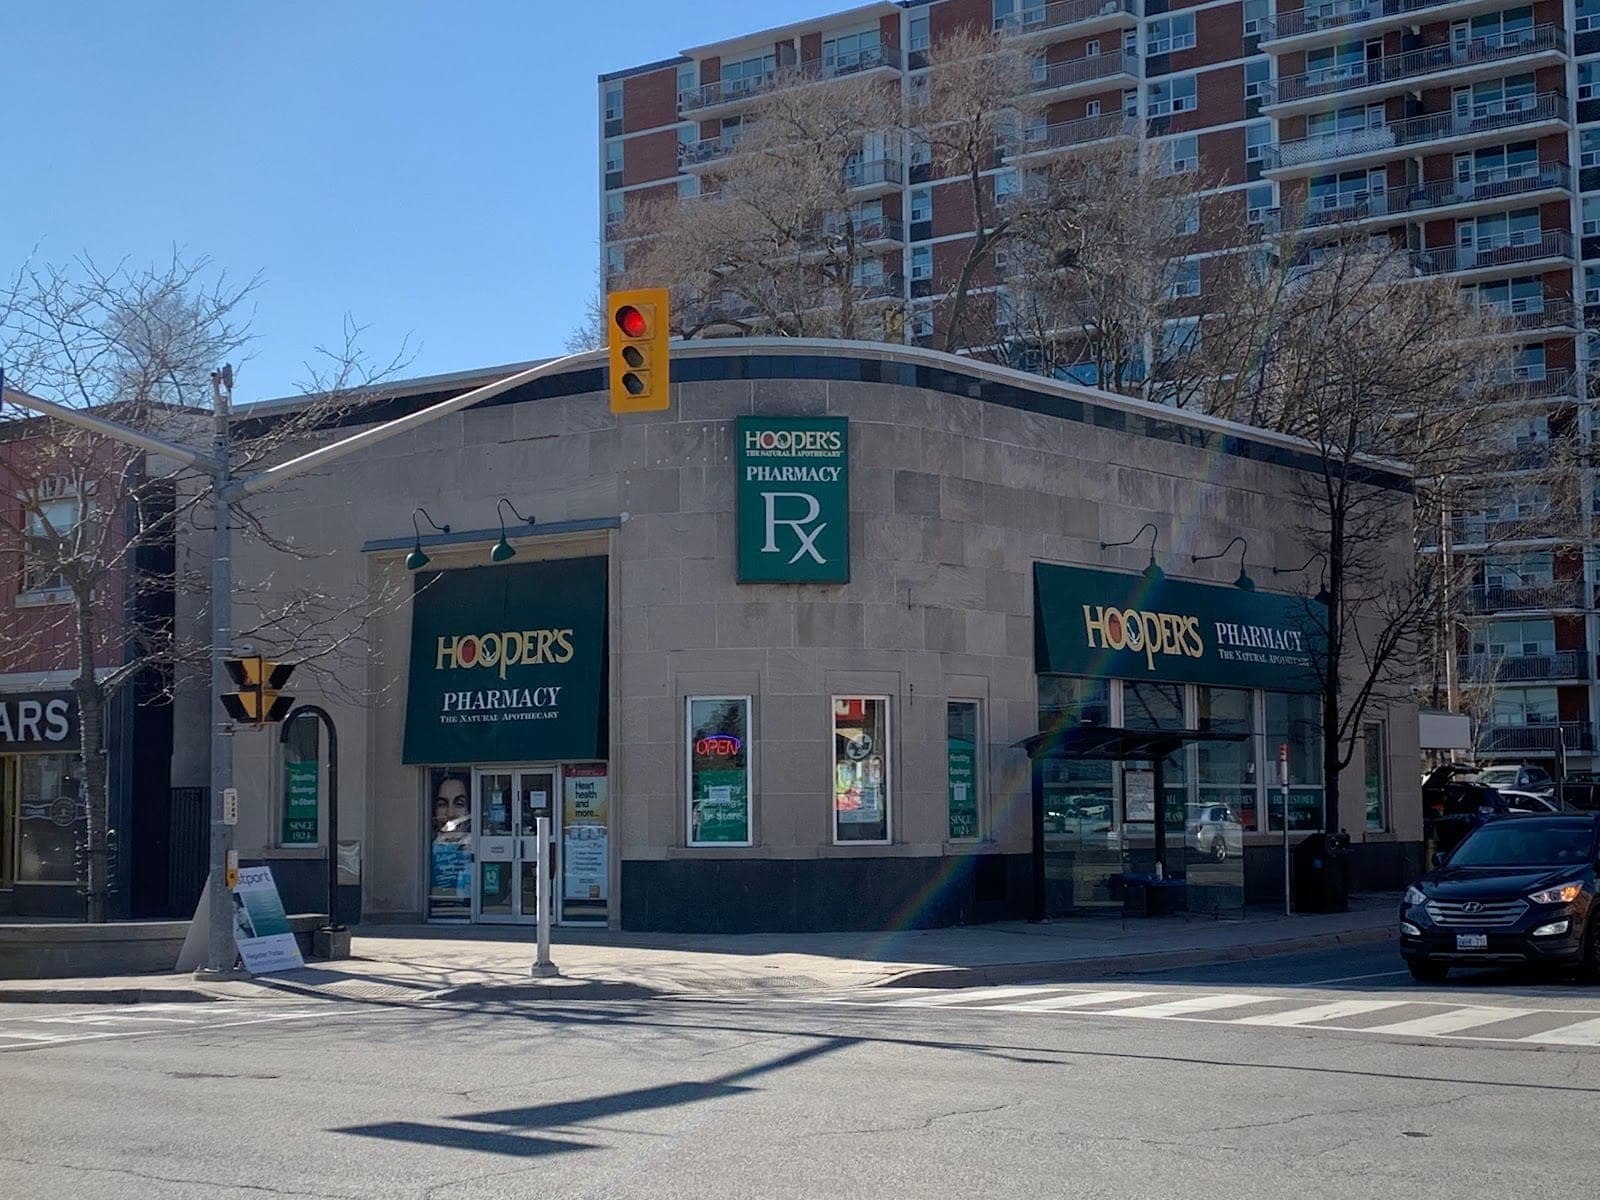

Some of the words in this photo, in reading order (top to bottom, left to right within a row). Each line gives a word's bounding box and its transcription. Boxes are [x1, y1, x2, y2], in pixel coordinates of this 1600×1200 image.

[745, 430, 841, 457] HOOPER'S
[746, 466, 841, 482] PHARMACY
[1082, 605, 1203, 670] HOOPER'S
[1215, 622, 1302, 652] PHARMACY
[435, 629, 574, 680] HOOPER'S
[442, 687, 562, 711] PHARMACY
[696, 739, 738, 755] OPEN
[575, 781, 594, 790] Heart
[575, 791, 597, 799] health
[575, 799, 589, 807] and
